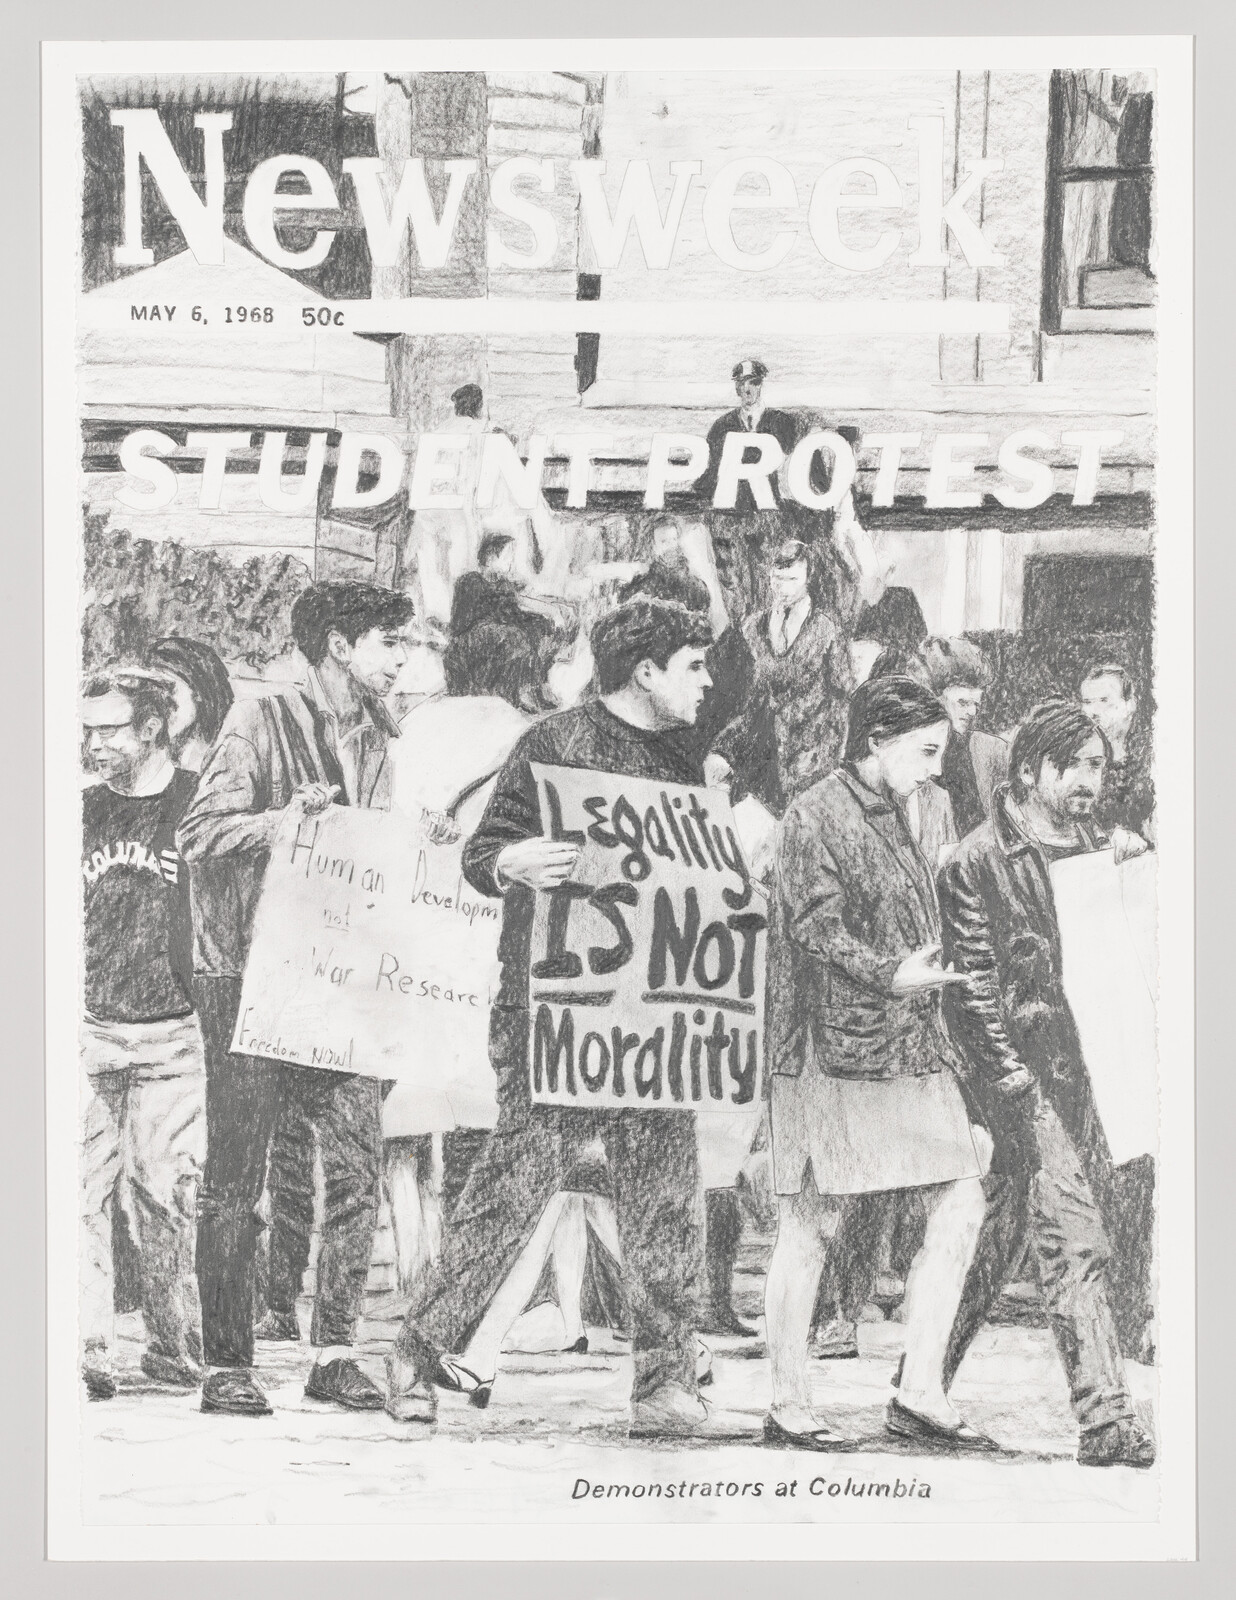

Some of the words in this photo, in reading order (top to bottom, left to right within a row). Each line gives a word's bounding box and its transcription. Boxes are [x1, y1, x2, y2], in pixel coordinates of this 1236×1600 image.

[110, 108, 1005, 271] Newsweek
[131, 304, 176, 321] MAY
[191, 305, 208, 325] 6,
[224, 306, 274, 323] 1968
[112, 429, 610, 512] STUDENT
[644, 428, 1124, 511] PROTEST
[290, 820, 384, 894] Human
[324, 902, 351, 926] not
[531, 879, 640, 979] IS
[312, 946, 354, 987] War
[238, 1006, 300, 1059] Freedom
[533, 1003, 757, 1104] Morality
[571, 1477, 765, 1500] Demonstrators
[775, 1479, 799, 1498] at
[809, 1476, 932, 1499] Columbia
